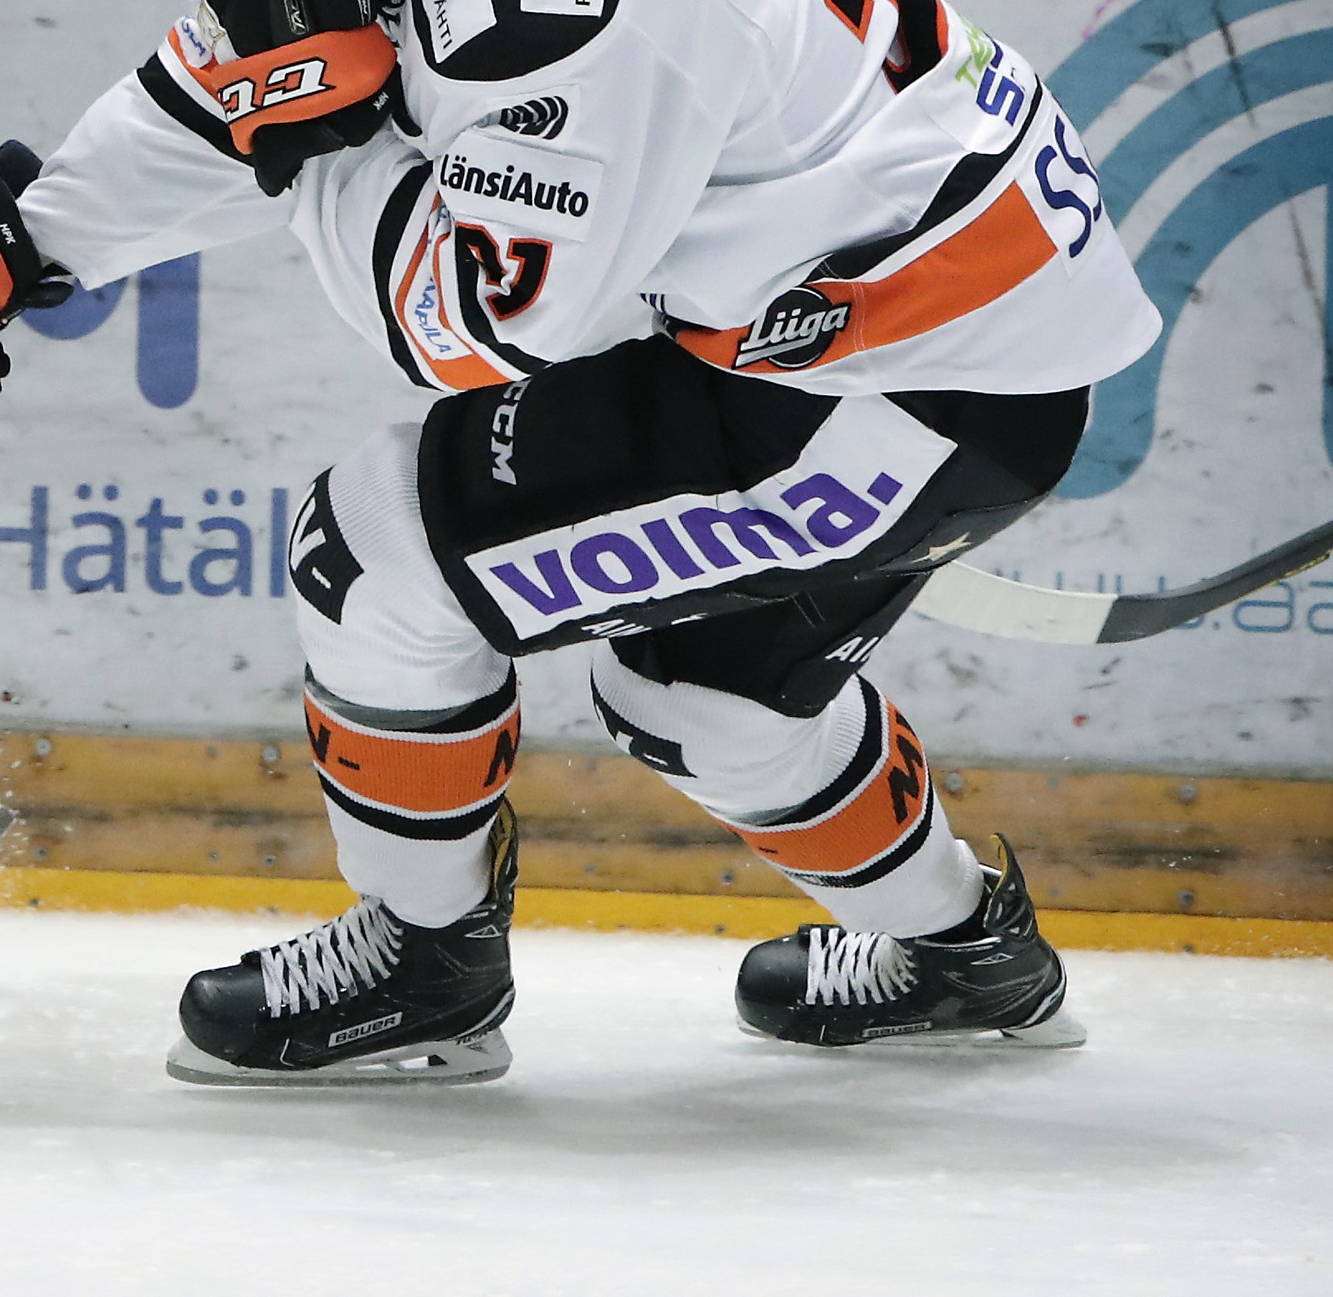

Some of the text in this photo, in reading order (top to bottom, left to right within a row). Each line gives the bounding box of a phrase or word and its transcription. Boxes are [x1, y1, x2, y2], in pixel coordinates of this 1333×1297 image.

[440, 153, 590, 218] LänsiAuto
[0, 223, 16, 245] HPK
[735, 301, 852, 364] Liiga
[489, 471, 904, 617] voima.
[335, 1015, 398, 1045] BAUER
